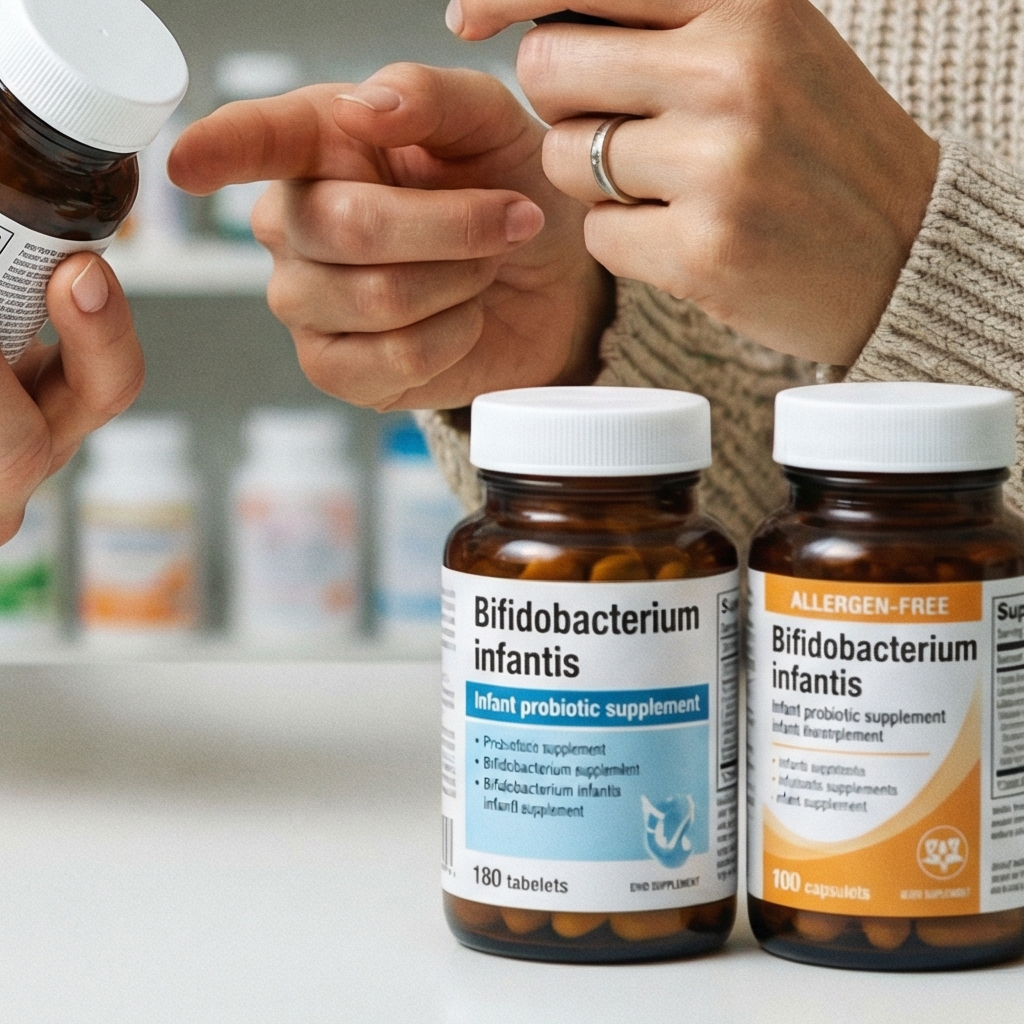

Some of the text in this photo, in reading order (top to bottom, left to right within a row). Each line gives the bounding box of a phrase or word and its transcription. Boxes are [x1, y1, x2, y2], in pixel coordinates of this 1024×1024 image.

[475, 595, 699, 635] Bifidobacterium
[790, 590, 950, 616] ALLERGEN-FREE
[475, 638, 580, 678] infantis
[772, 625, 978, 663] Bifidobacterium
[772, 661, 863, 698] infantis
[474, 690, 701, 721] Infant probiotic supplement
[804, 706, 860, 722] probiotic
[865, 709, 946, 728] supplement
[473, 865, 568, 893] 180 tabelets
[772, 868, 801, 892] 100
